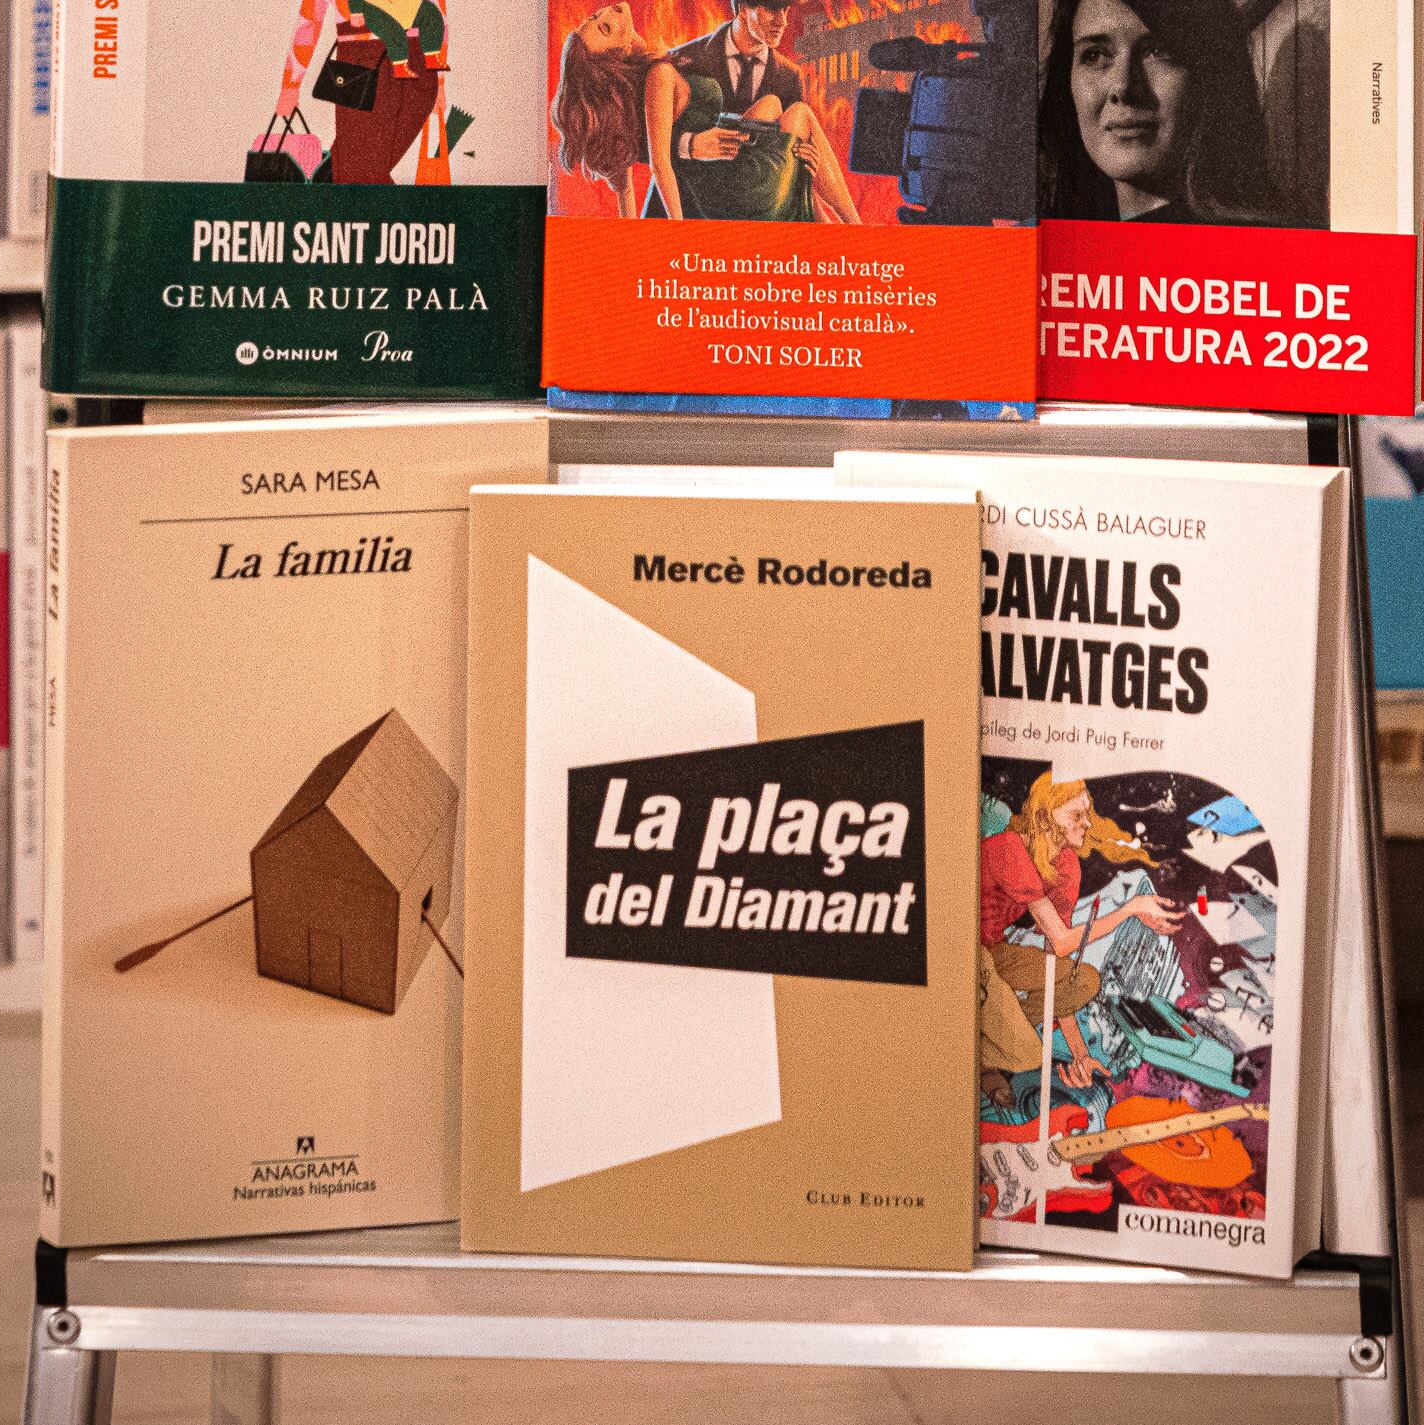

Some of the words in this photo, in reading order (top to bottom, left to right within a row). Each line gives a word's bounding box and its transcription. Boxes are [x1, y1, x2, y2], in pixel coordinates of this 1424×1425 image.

[93, 17, 117, 78] PREMI
[1372, 62, 1382, 124] Narratives
[194, 221, 284, 262] PREMI
[293, 222, 369, 263] SANT
[376, 224, 454, 263] JORDI
[670, 253, 726, 272] «Una
[734, 254, 811, 274] mirada
[817, 256, 904, 280] salvatge
[162, 285, 290, 309] GEMMA
[308, 287, 389, 310] RUIZ
[407, 283, 488, 310] PALÀ
[638, 280, 642, 298] i
[650, 280, 737, 301] hilarant
[744, 282, 802, 302] sobre
[809, 283, 837, 303] les
[844, 280, 936, 305] misèries
[1139, 276, 1282, 319] NOBEL
[1295, 282, 1351, 321] DE
[657, 307, 682, 327] de
[688, 307, 823, 331] l'audiovisual
[829, 313, 914, 333] català».
[262, 346, 337, 361] ÒMNIUM
[361, 331, 413, 361] Proa
[708, 345, 771, 365] TONI
[780, 347, 862, 367] SOLER
[1263, 331, 1370, 372] 2022
[242, 472, 306, 495] SARA
[316, 470, 380, 491] MESA
[1015, 506, 1087, 531] CUSSÀ
[1097, 512, 1207, 539] BALAGUER
[213, 544, 261, 579] La
[275, 537, 412, 577] familia
[634, 555, 744, 584] Mercè
[758, 558, 931, 588] Rodoreda
[1022, 722, 1042, 739] de
[1045, 725, 1080, 744] Jordi
[1086, 729, 1117, 750] Puig
[1123, 732, 1165, 749] Ferrer
[593, 778, 682, 850] La
[698, 782, 911, 877] plaça
[584, 873, 670, 927] del
[684, 875, 917, 937] Diamant
[250, 1159, 359, 1183] ANAGRAMA
[232, 1184, 304, 1201] Narrativas
[308, 1179, 377, 1197] hispánicas
[806, 1191, 851, 1205] CLUB
[860, 1192, 924, 1207] EDITOR
[1123, 1206, 1267, 1245] comanegra
